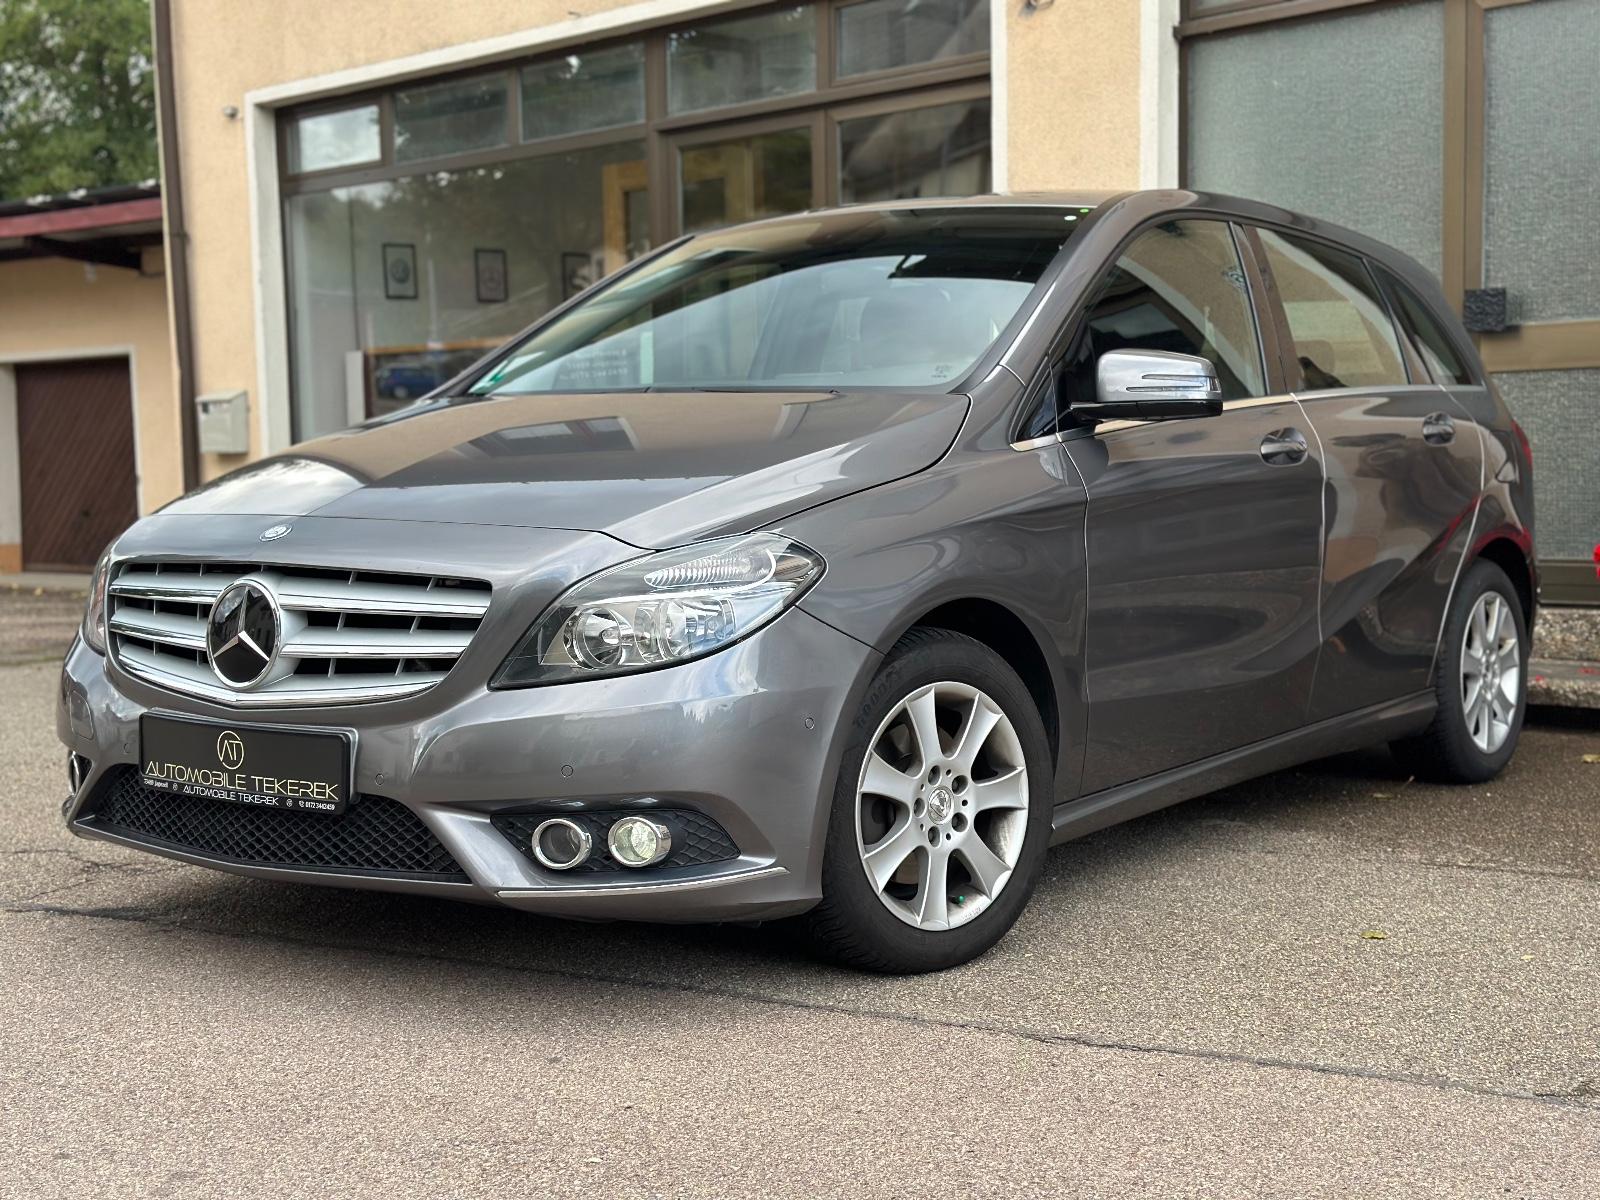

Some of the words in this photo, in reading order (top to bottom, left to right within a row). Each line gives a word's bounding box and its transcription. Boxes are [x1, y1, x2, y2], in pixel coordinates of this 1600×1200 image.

[219, 738, 243, 763] AT
[145, 760, 247, 791] AUTOMOBILE
[250, 775, 339, 801] TEKEREK
[183, 785, 237, 801] AUTOMOBILE
[238, 792, 279, 806] TEKEREK
